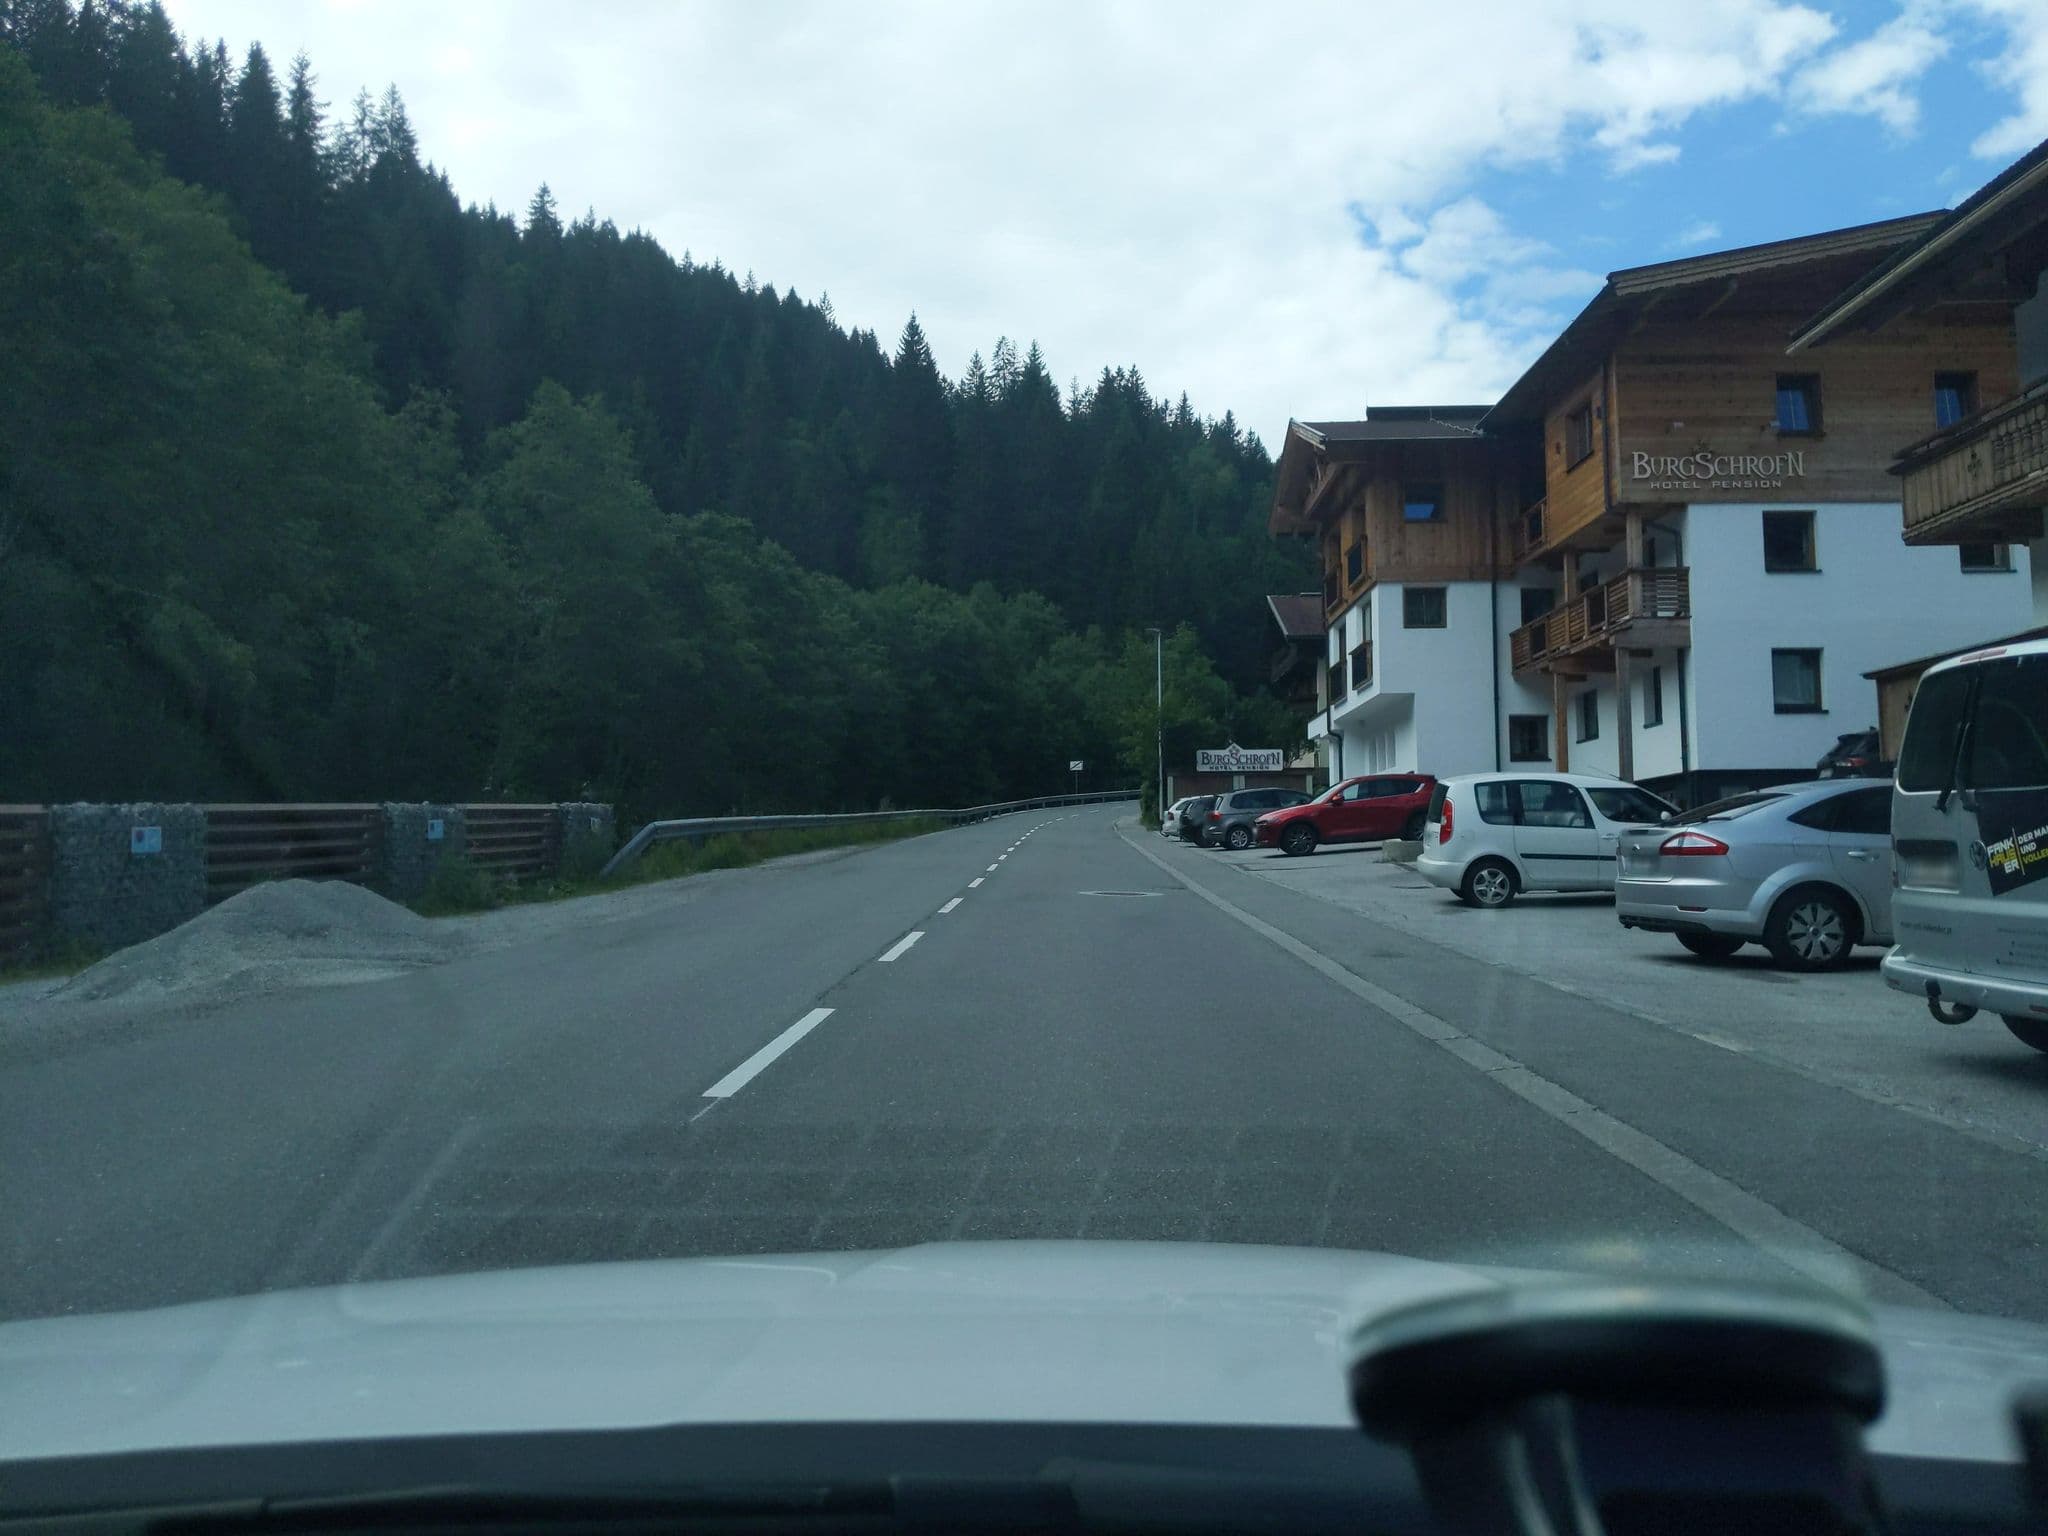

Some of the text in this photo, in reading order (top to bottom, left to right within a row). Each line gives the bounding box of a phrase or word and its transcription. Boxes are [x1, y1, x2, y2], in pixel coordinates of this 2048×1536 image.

[1651, 479, 1782, 489] HOTEL PENSION
[2017, 831, 2034, 845] DER
[2020, 842, 2037, 854] UND
[2004, 859, 2020, 873] ER
